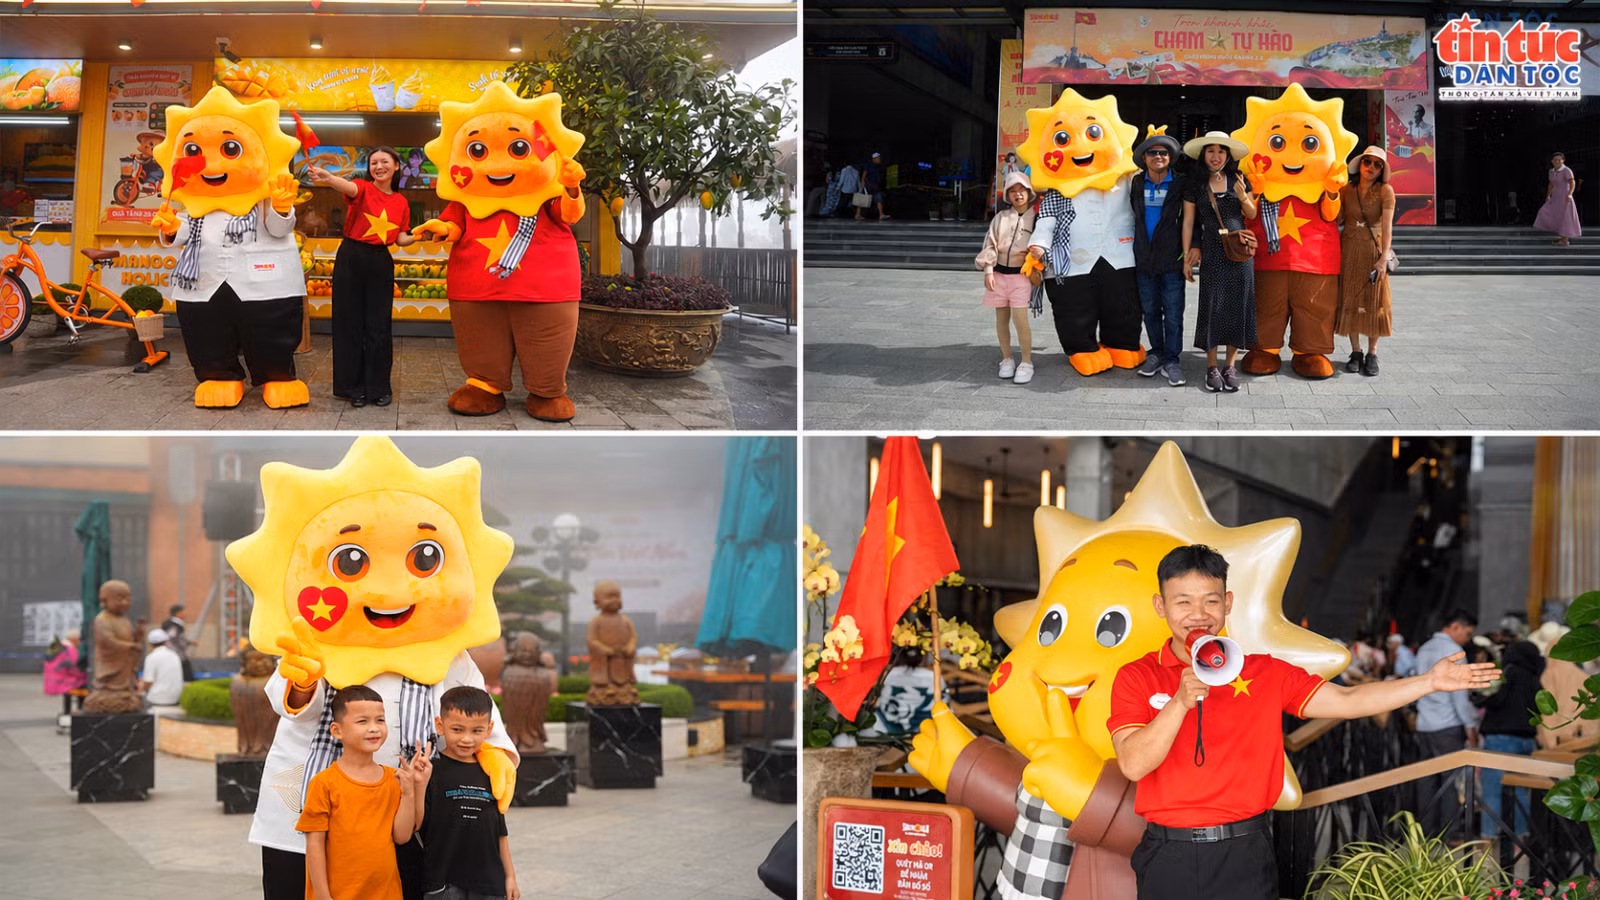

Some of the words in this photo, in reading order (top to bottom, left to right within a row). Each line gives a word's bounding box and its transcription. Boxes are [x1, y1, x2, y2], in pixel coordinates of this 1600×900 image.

[1154, 31, 1204, 52] CHẠM
[1231, 32, 1255, 53] TỰ
[1258, 29, 1293, 52] HÀO
[113, 254, 176, 269] MANGO
[122, 271, 169, 287] HOLIC
[887, 838, 908, 854] Xin
[910, 840, 943, 858] chào!
